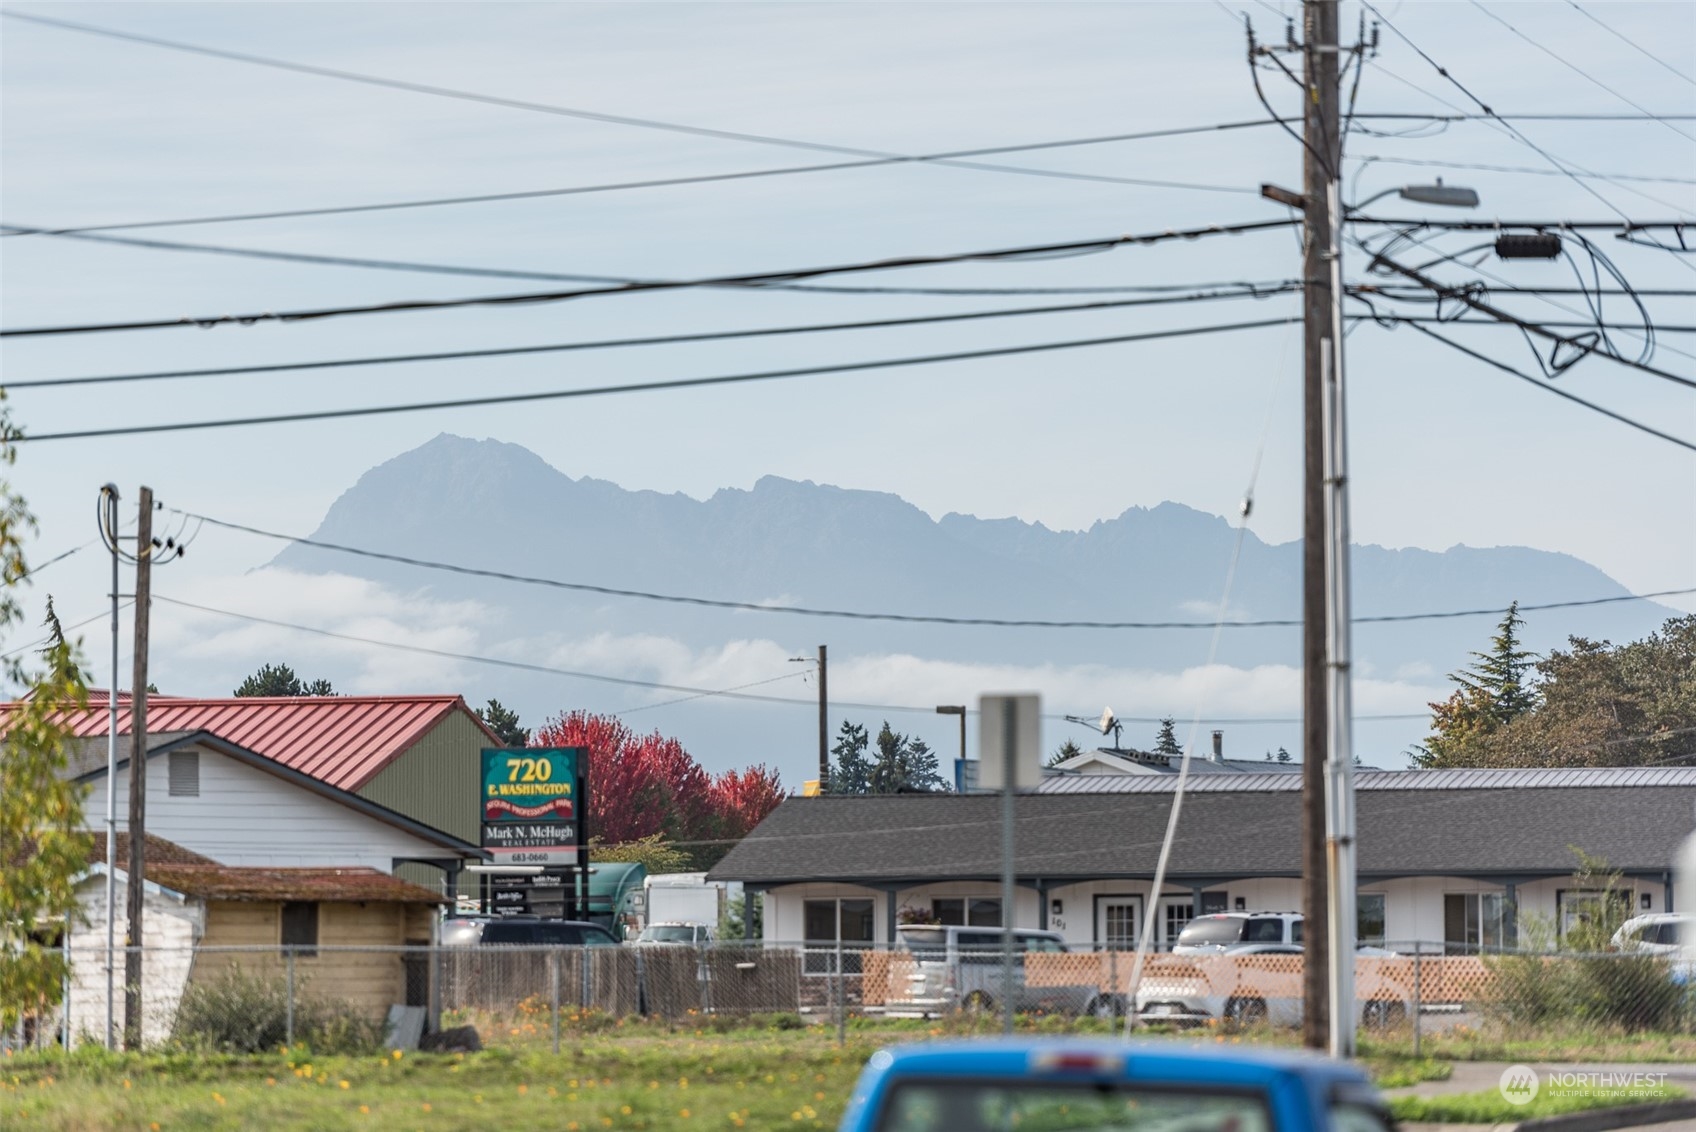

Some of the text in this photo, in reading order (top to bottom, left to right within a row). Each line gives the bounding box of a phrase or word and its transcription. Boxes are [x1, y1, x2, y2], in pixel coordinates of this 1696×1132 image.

[507, 757, 552, 782] 720
[488, 783, 572, 796] E. WASHINGTON
[487, 825, 574, 842] Mark N. McHugh
[511, 853, 549, 863] 683-0660
